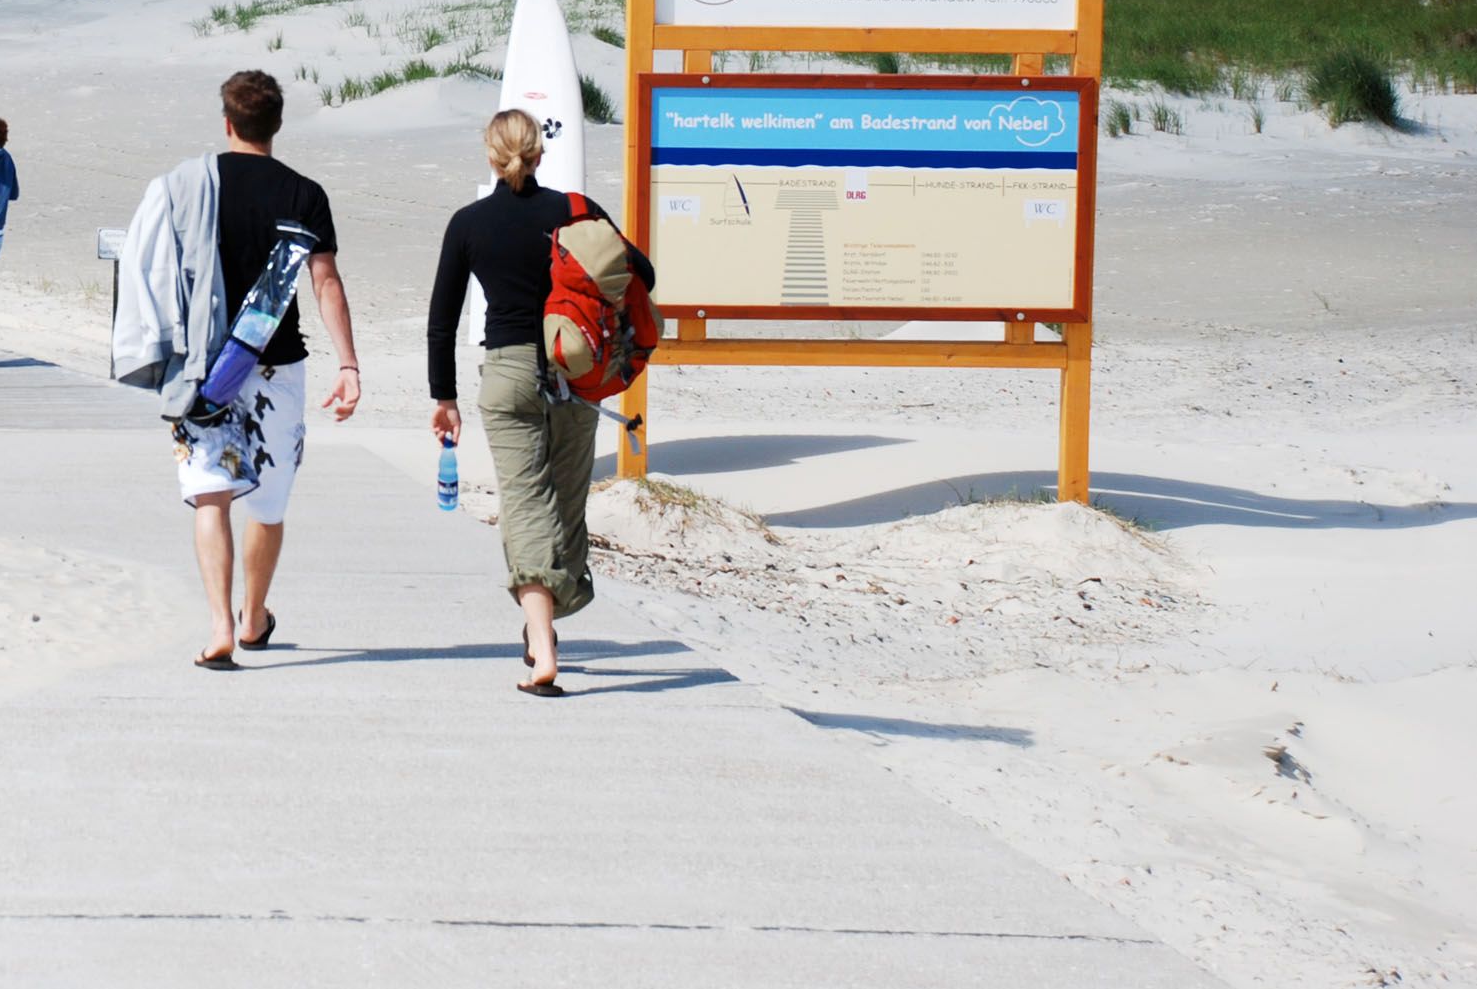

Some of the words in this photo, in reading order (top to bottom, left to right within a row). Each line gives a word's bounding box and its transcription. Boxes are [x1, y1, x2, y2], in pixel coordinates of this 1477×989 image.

[830, 116, 854, 130] am
[861, 113, 957, 131] Badestrand
[964, 118, 992, 131] von
[998, 115, 1049, 132] Nebel
[779, 179, 838, 188] BADESTRAND
[846, 191, 867, 200] DLRG
[669, 199, 693, 212] WC
[1034, 203, 1057, 215] WC
[709, 218, 753, 226] Surfschule
